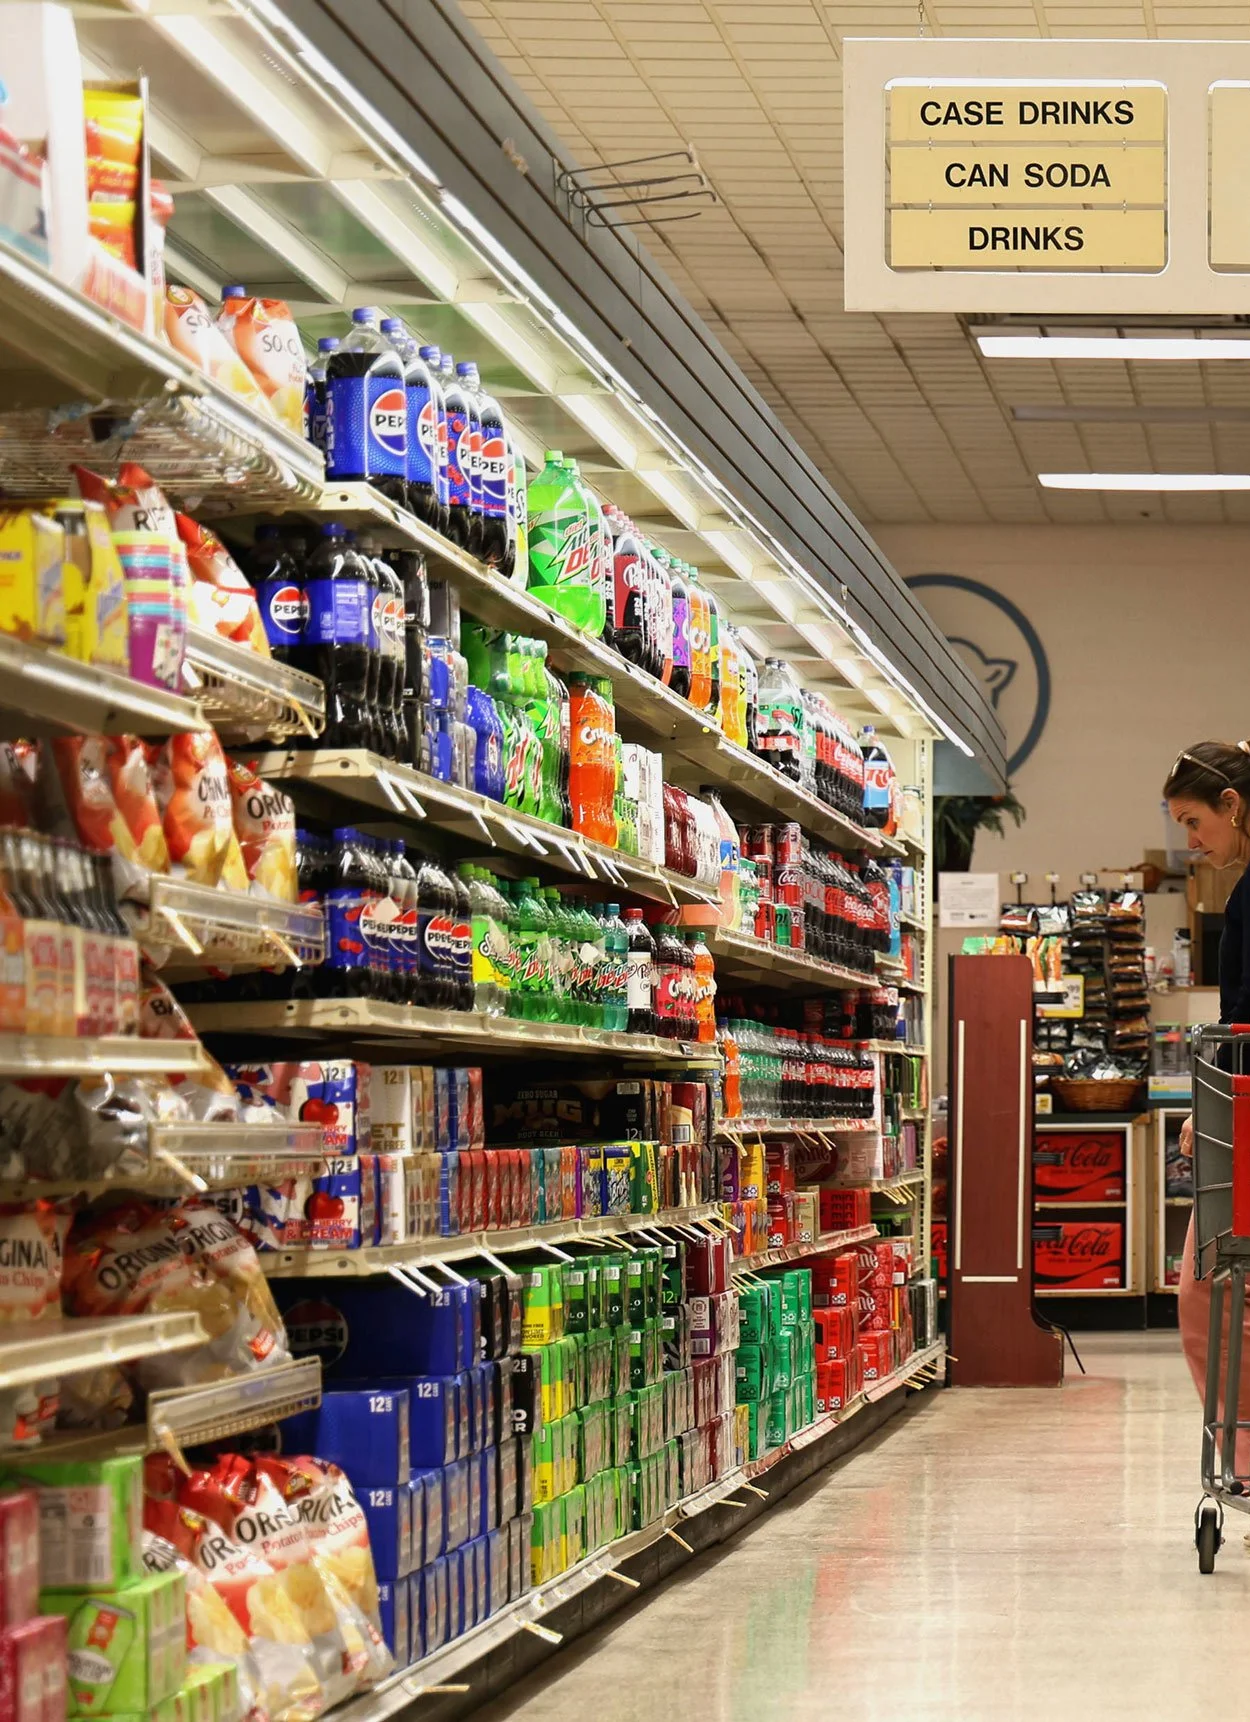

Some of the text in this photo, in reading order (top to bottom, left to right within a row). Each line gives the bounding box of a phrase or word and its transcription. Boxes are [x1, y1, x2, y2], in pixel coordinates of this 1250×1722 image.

[920, 99, 1134, 126] CASE DRINKS
[945, 162, 1111, 188] CAN SODA
[968, 226, 1085, 251] DRINKS
[493, 1099, 583, 1124] MUG
[330, 1160, 346, 1175] 12
[417, 1383, 432, 1398] 12
[369, 1396, 385, 1413] 12
[369, 1491, 385, 1507] 12
